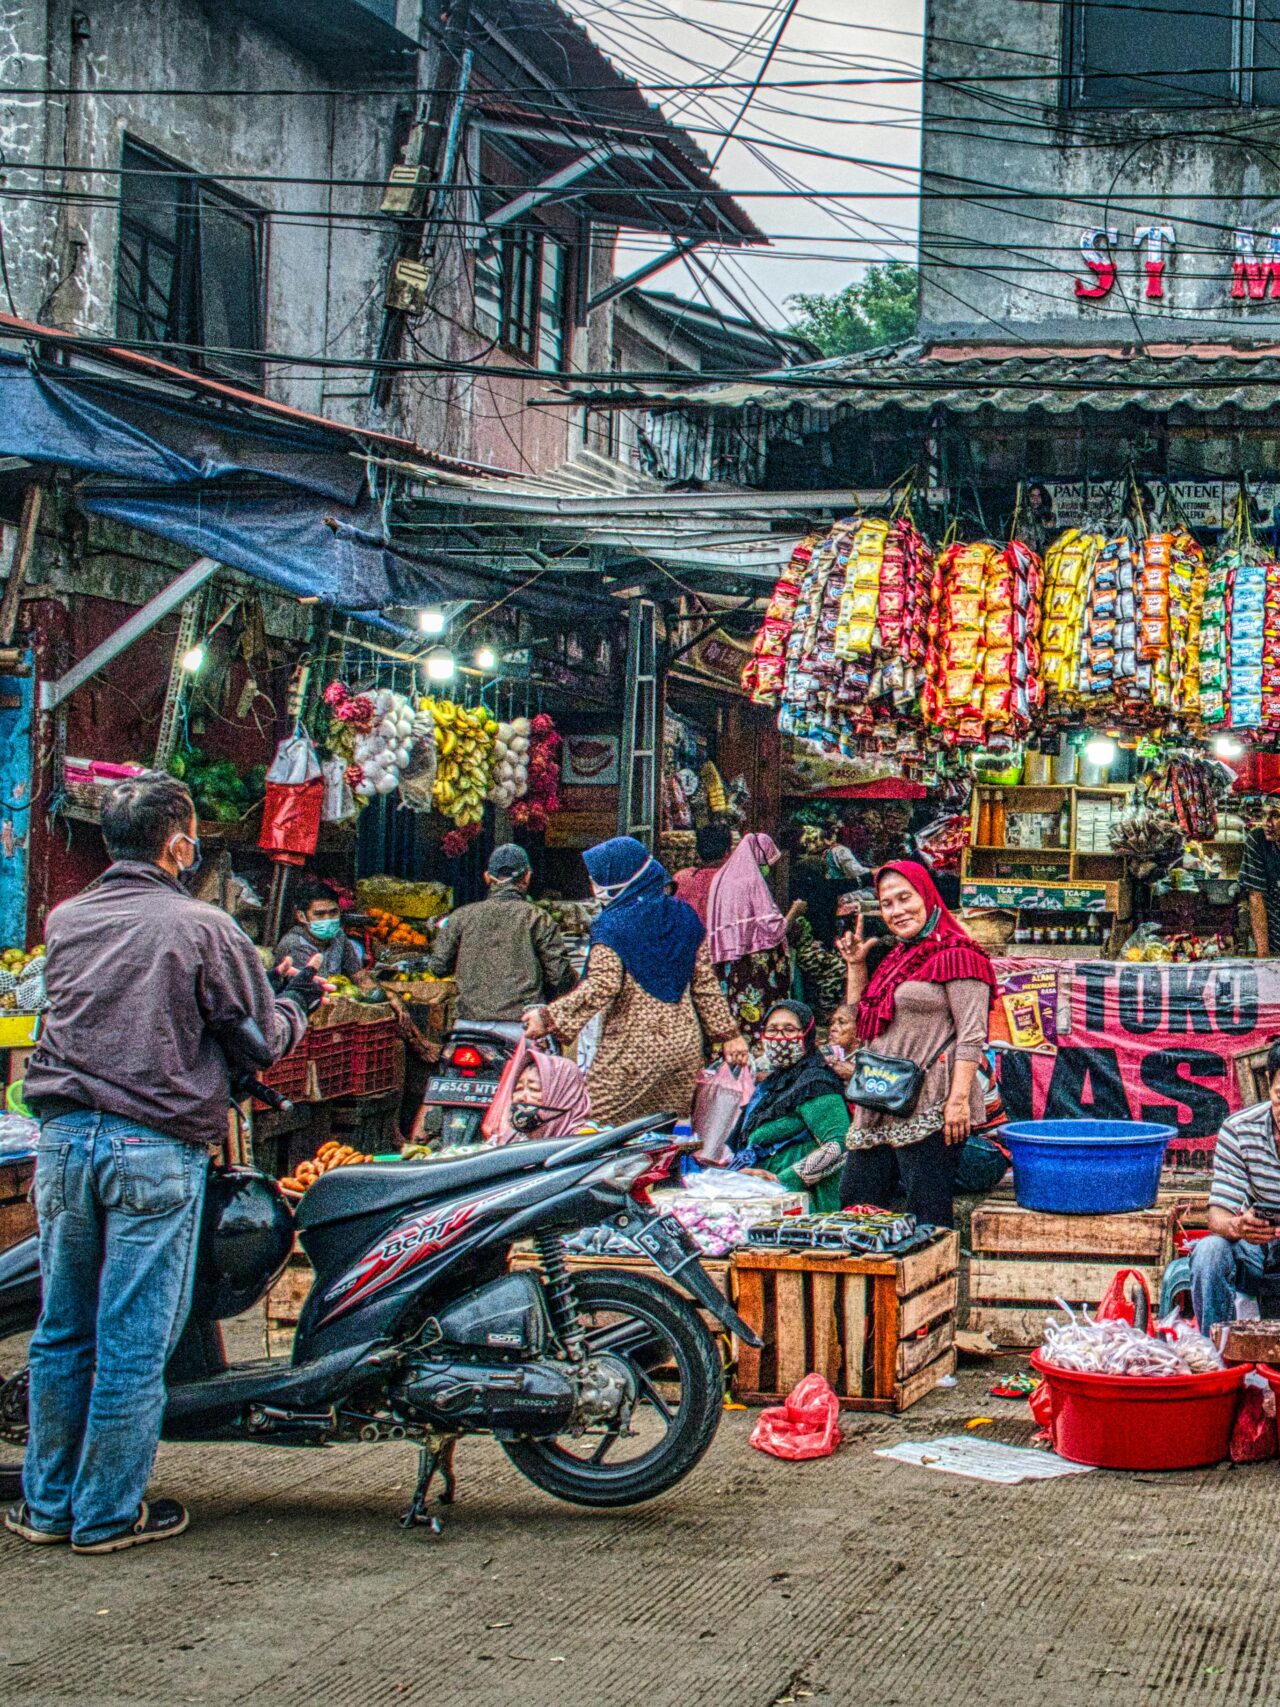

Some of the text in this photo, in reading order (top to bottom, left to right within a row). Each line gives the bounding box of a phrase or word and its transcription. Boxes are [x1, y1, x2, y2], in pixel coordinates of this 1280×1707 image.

[1075, 225, 1176, 299] ST
[1064, 890, 1091, 898] TCA-65
[1075, 962, 1259, 1035] TOKO
[431, 1081, 439, 1090] B
[641, 1235, 661, 1254] B
